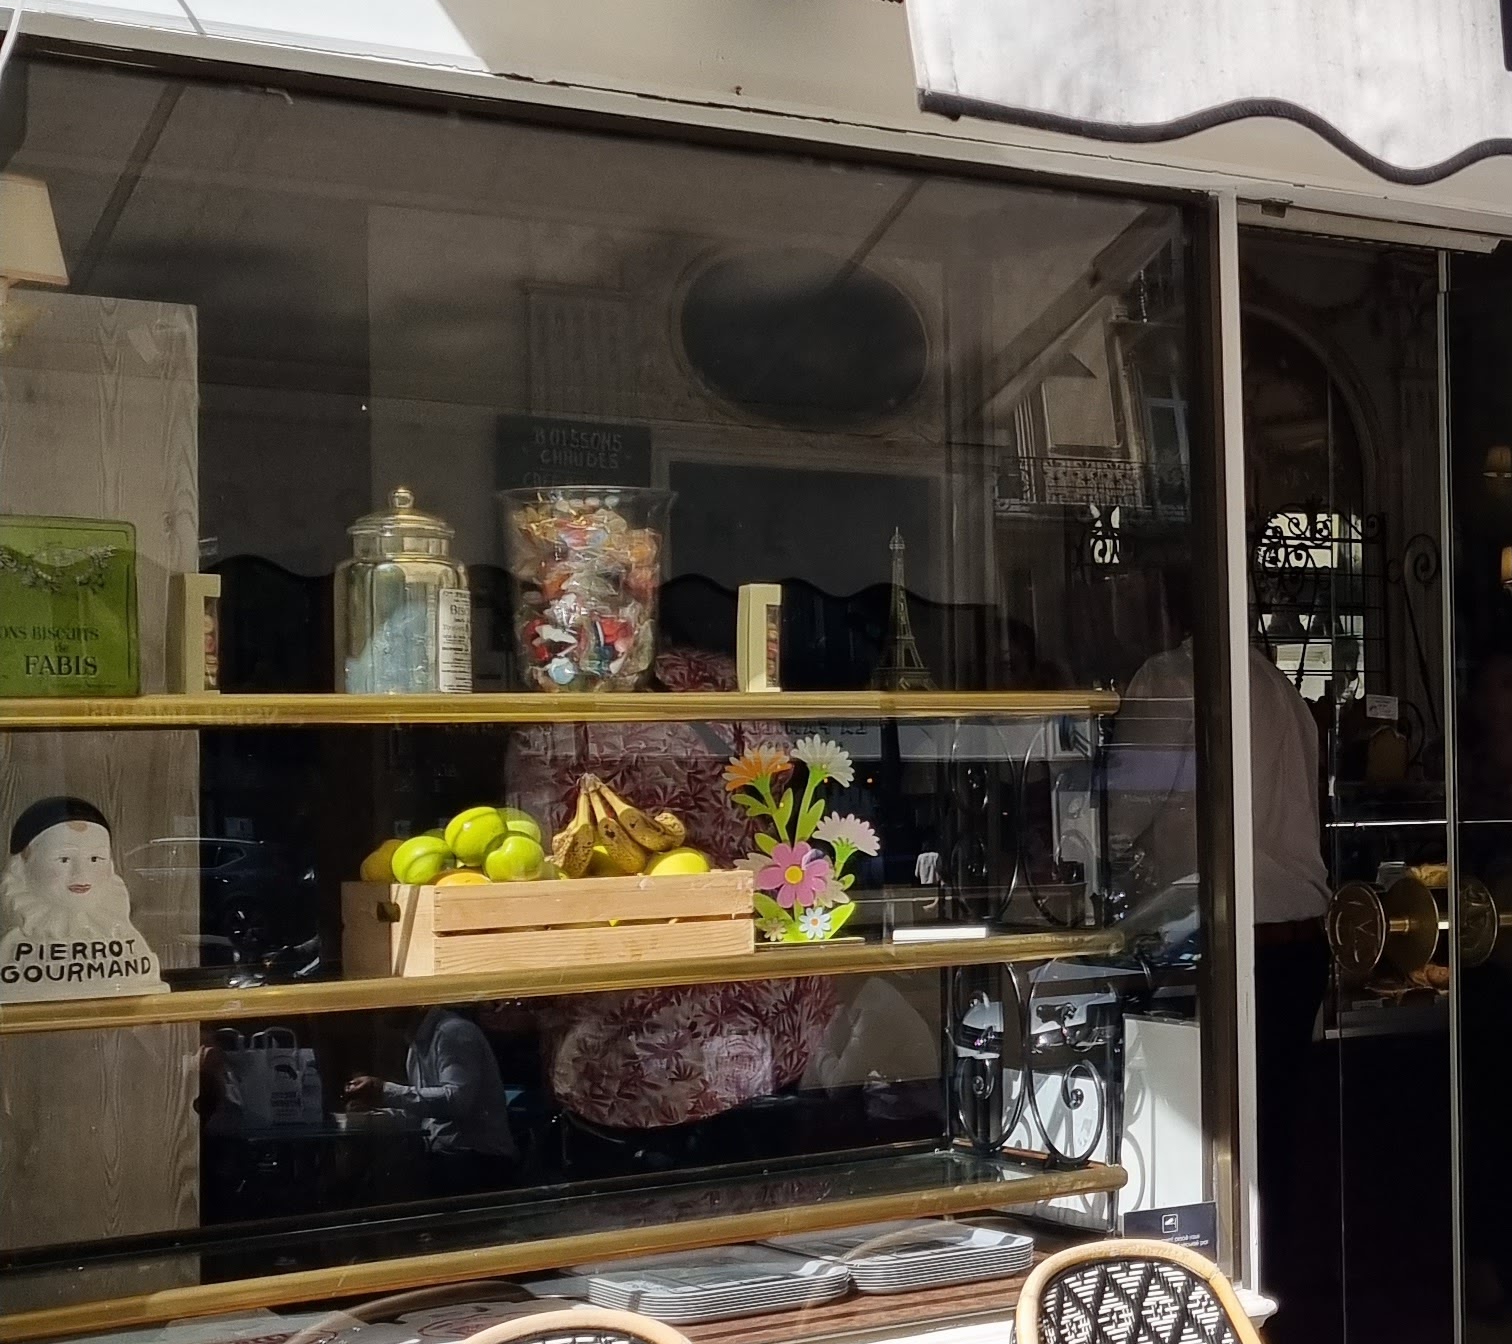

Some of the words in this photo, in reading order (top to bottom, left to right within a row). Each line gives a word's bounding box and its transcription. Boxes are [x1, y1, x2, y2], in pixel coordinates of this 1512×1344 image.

[24, 654, 99, 676] FABIS
[14, 938, 136, 962] PIERROT
[0, 956, 152, 984] GOURMAND
